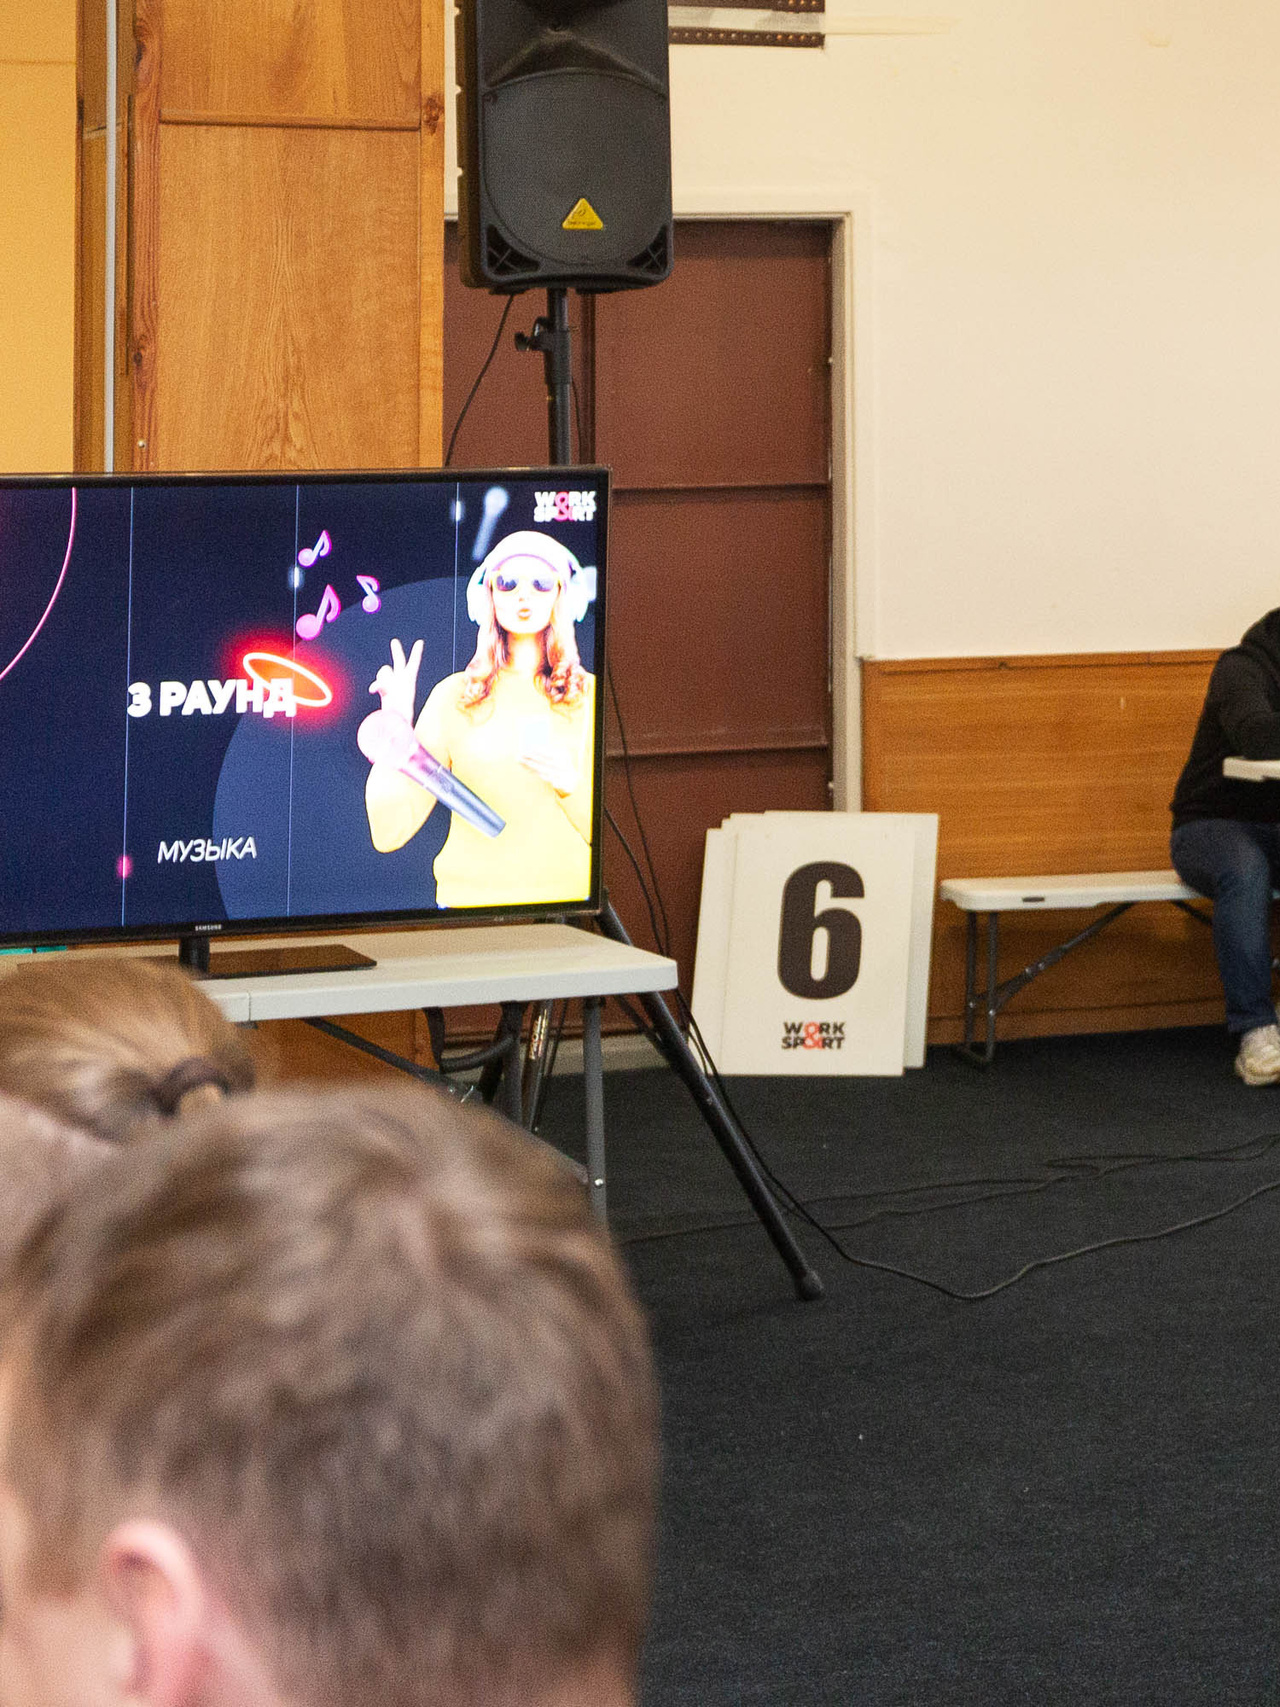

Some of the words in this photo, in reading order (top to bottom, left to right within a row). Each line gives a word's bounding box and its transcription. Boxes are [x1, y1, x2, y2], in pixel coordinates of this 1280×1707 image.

[127, 681, 152, 718] 3
[159, 677, 297, 718] РАУНД
[157, 836, 257, 864] МУЗЫКА
[777, 861, 865, 1000] 6
